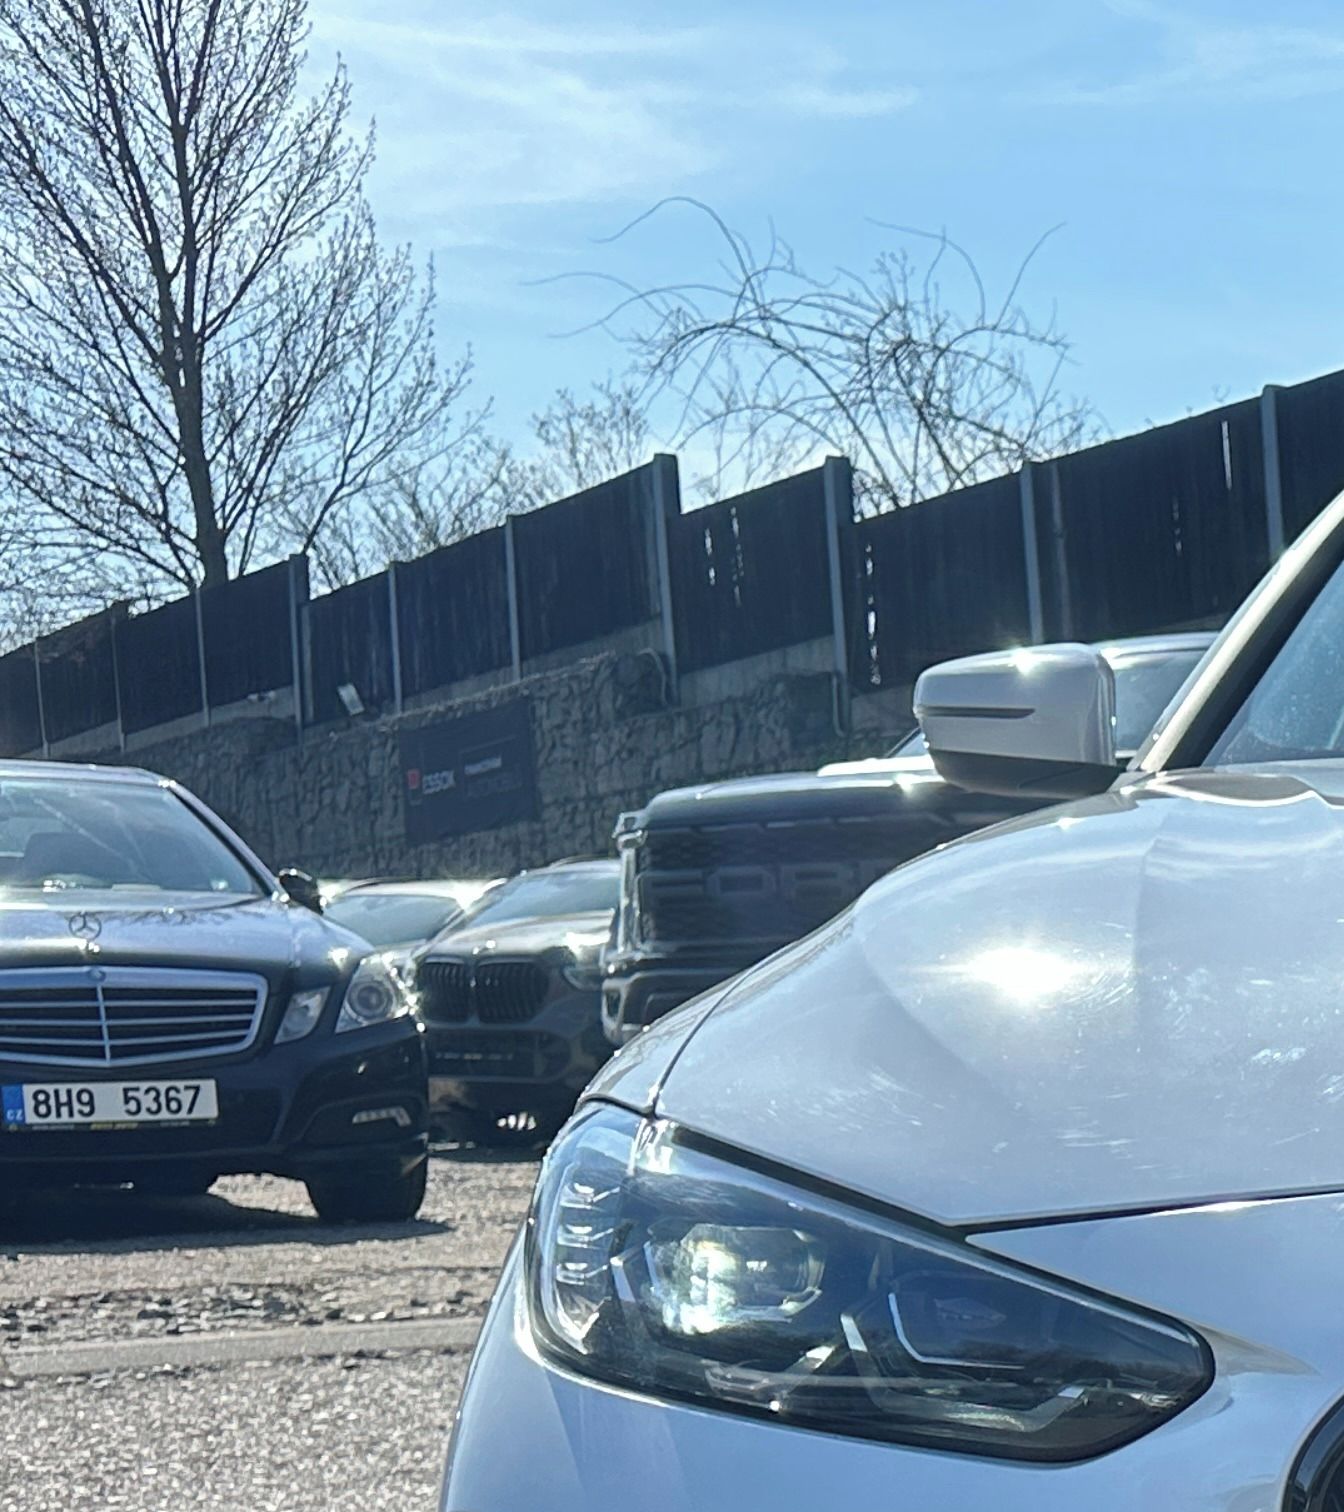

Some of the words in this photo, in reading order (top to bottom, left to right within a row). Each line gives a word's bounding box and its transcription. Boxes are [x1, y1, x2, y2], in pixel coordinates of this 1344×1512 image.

[32, 1088, 95, 1119] 8H9
[122, 1085, 202, 1116] 5367
[6, 1109, 23, 1121] CZ
